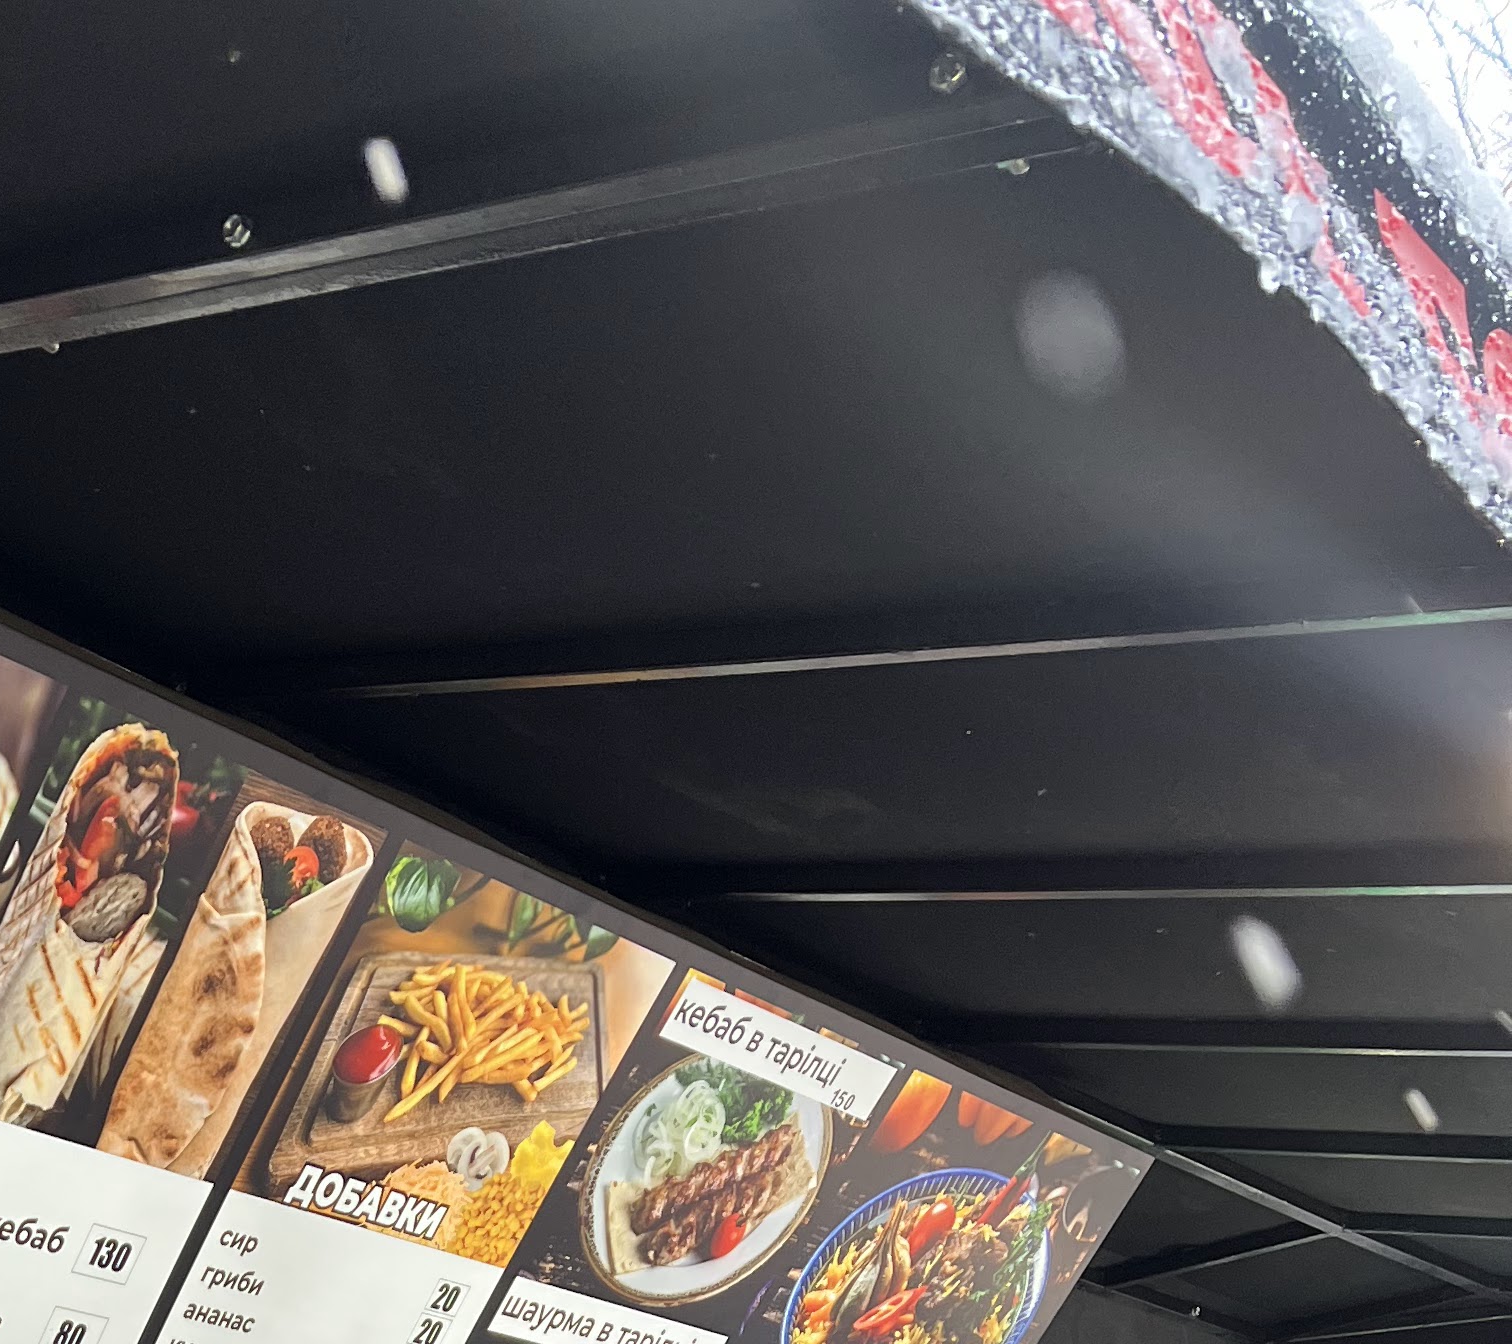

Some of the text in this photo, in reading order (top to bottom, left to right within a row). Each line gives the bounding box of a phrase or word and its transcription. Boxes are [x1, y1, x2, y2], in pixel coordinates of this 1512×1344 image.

[674, 999, 846, 1091] кебаб в тарілці
[830, 1088, 856, 1111] 150
[285, 1161, 448, 1241] ДОБАВКИ
[88, 1237, 134, 1274] 130
[219, 1226, 259, 1259] сир
[201, 1262, 265, 1297] гриби
[430, 1283, 460, 1313] 20
[183, 1303, 255, 1334] ананас
[597, 1323, 613, 1342] в
